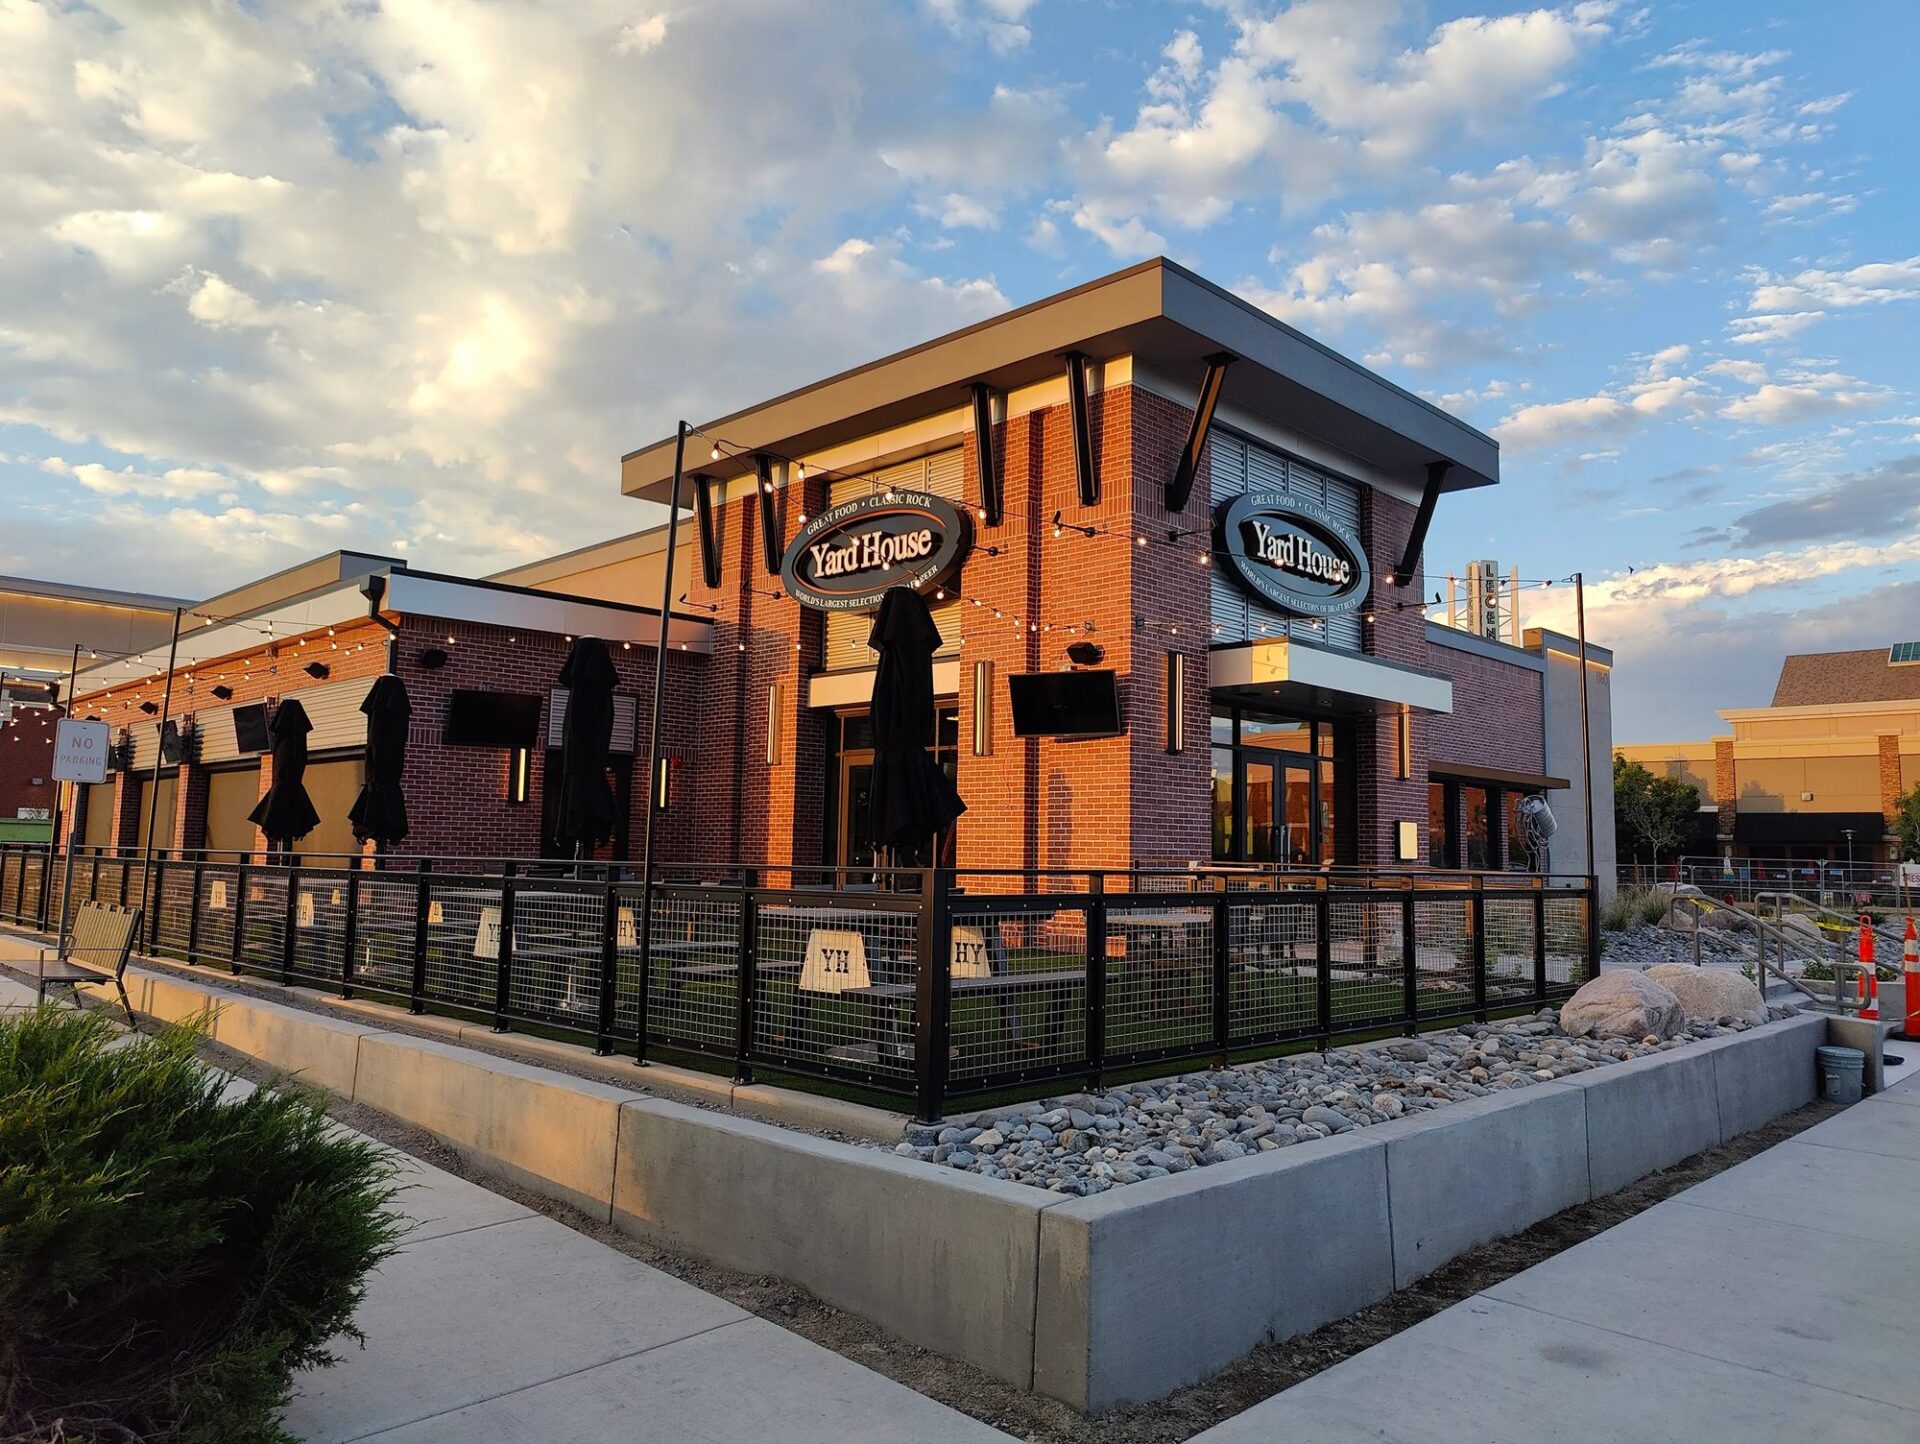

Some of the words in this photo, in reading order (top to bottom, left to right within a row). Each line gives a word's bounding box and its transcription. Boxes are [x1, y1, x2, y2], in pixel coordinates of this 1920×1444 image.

[807, 513, 834, 535] GREAT
[835, 502, 858, 519] FOOD
[906, 494, 932, 508] ROCK
[1251, 495, 1274, 506] GREAT
[1276, 496, 1296, 508] FOOD
[1304, 503, 1331, 525] CLASSIC
[1332, 520, 1351, 542] ROCK
[810, 541, 860, 578] Yard
[860, 528, 933, 569] House
[1252, 521, 1295, 567] Yard
[1296, 536, 1350, 585] House
[795, 589, 820, 606] WORLD'S
[820, 598, 847, 608] LARGEST
[1291, 598, 1320, 612] SELECTION
[71, 736, 93, 750] NO
[60, 753, 102, 766] PARKING
[822, 948, 849, 974] YH
